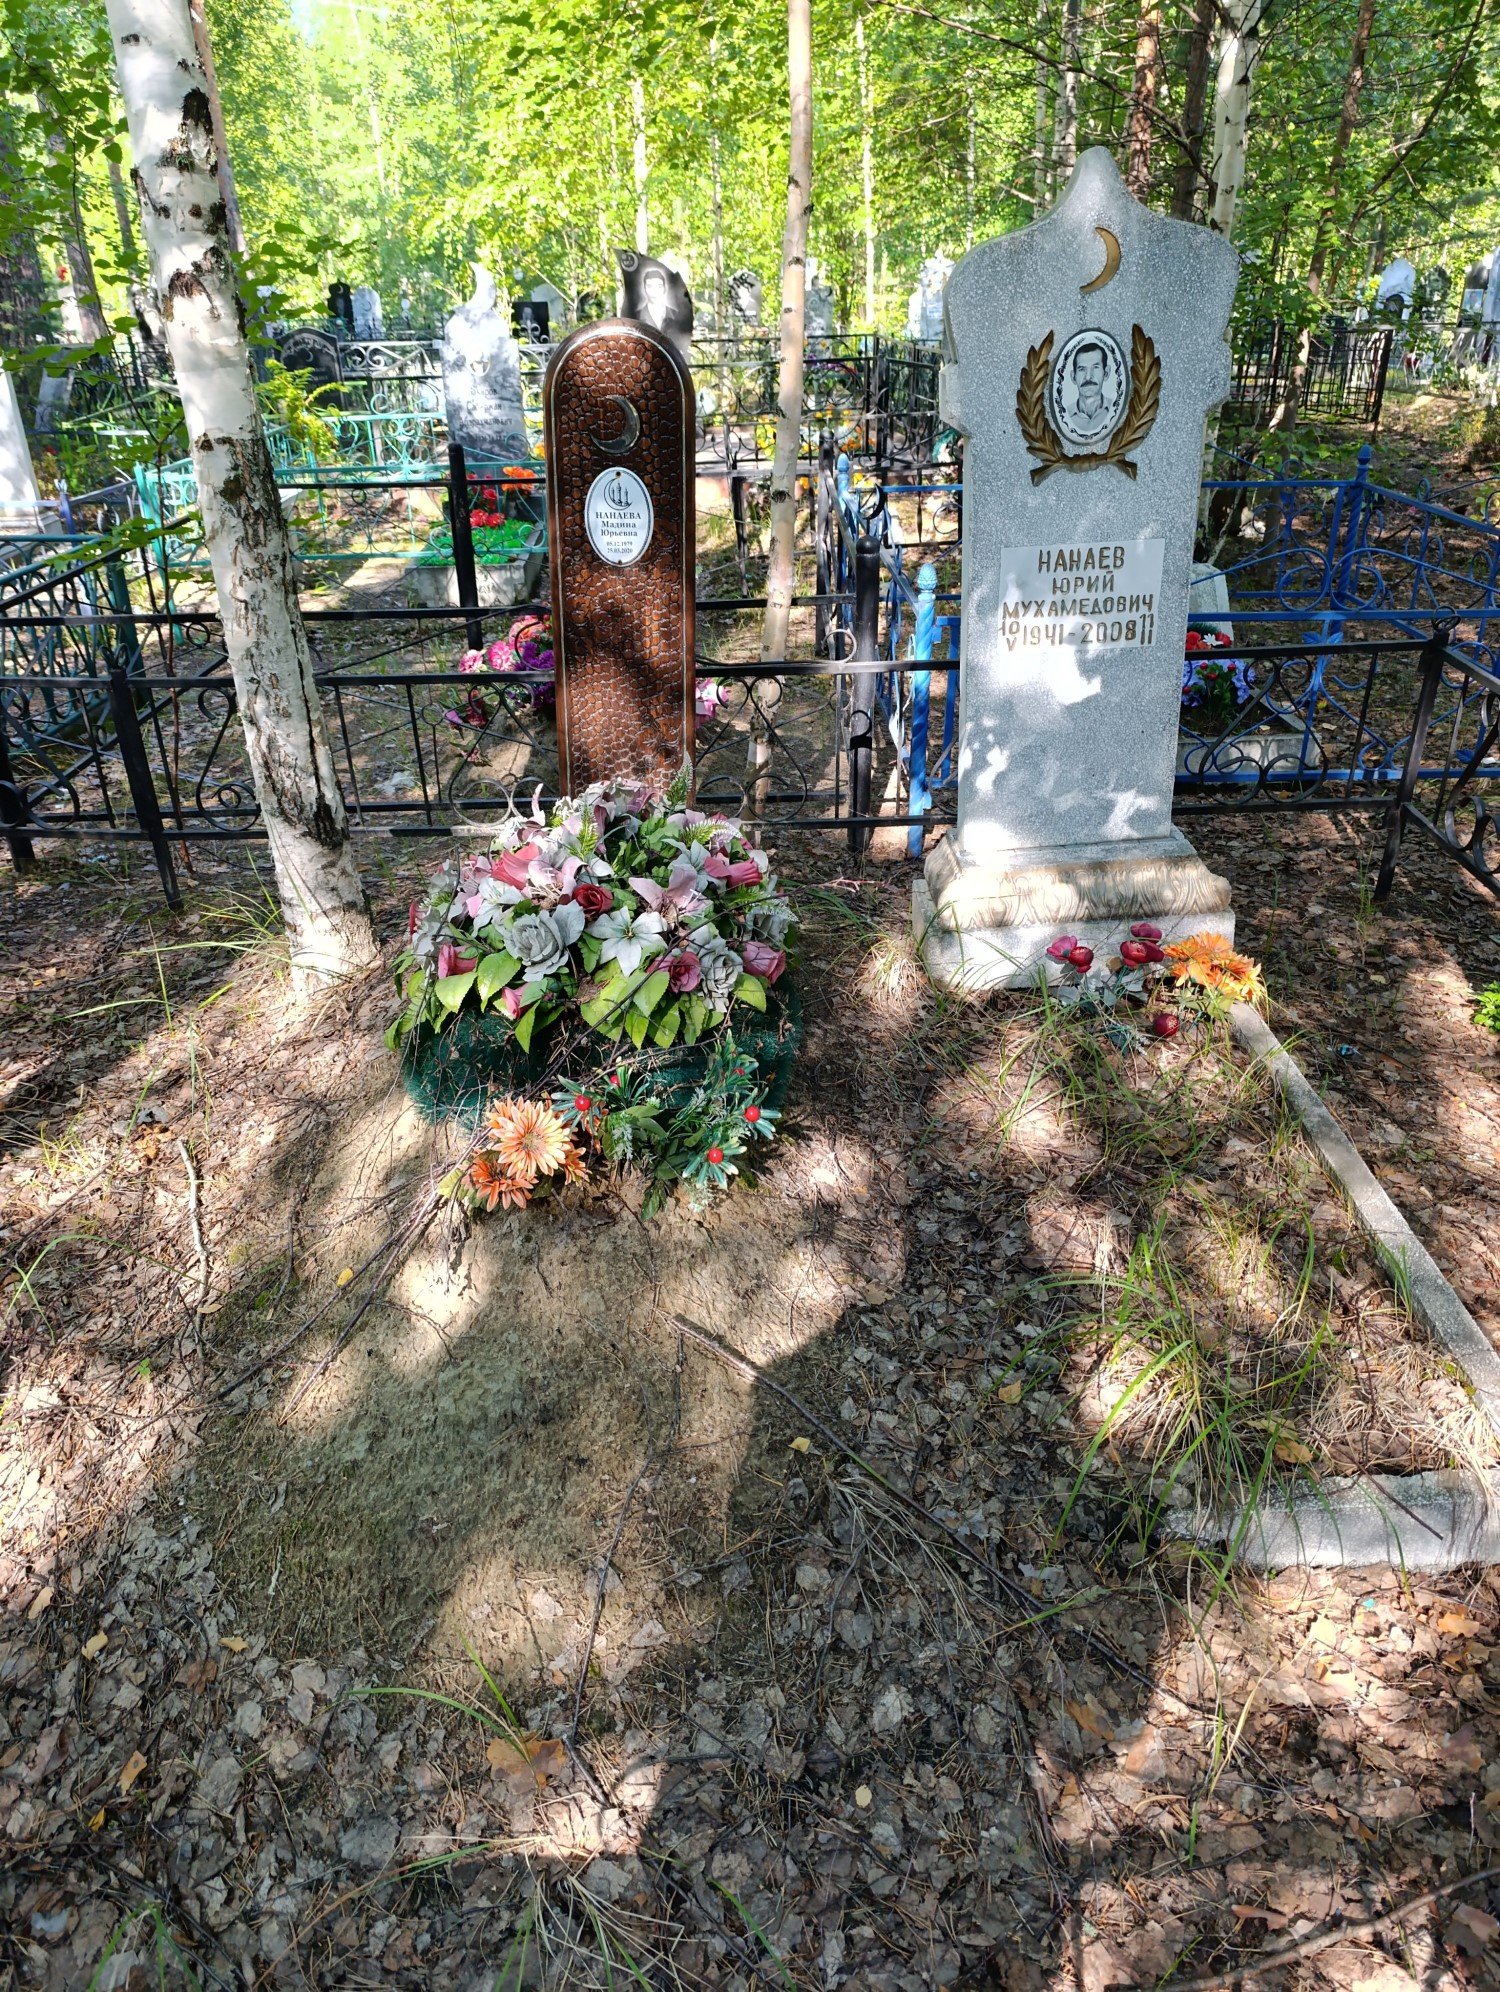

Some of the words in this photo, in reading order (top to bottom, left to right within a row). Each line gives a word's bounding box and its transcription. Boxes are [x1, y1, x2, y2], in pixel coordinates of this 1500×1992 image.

[595, 511, 642, 520] НАНАЕВА
[601, 520, 637, 529] Мадина
[600, 529, 638, 538] Юрьевна
[1038, 546, 1125, 574] НАНАЕВ
[1052, 571, 1115, 595] ЮРИЙ
[1001, 593, 1154, 620] МУХАМЕДОВИЧ
